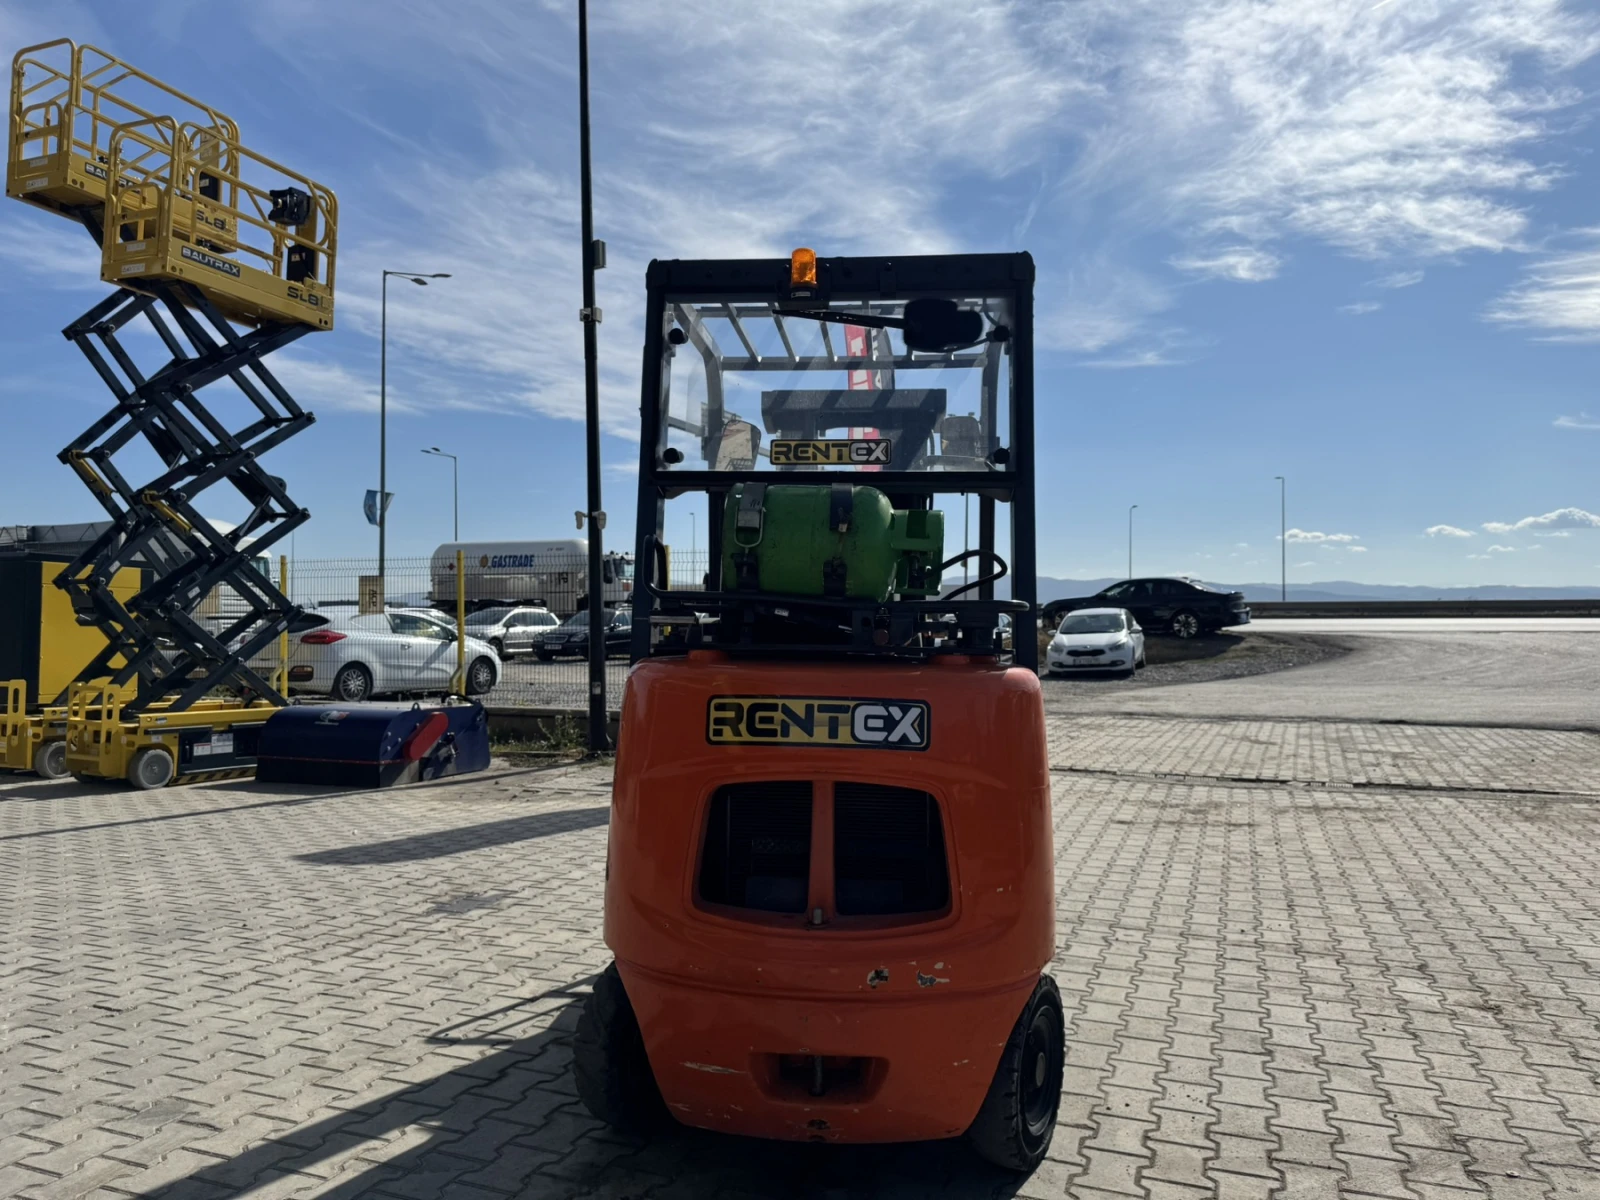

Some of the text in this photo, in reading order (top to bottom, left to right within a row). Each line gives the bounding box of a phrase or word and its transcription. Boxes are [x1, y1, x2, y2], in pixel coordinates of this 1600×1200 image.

[182, 247, 240, 275] BAUTRAX
[773, 442, 887, 462] RENTEX
[491, 554, 535, 569] GASTRADE
[712, 702, 922, 744] RENTEX
